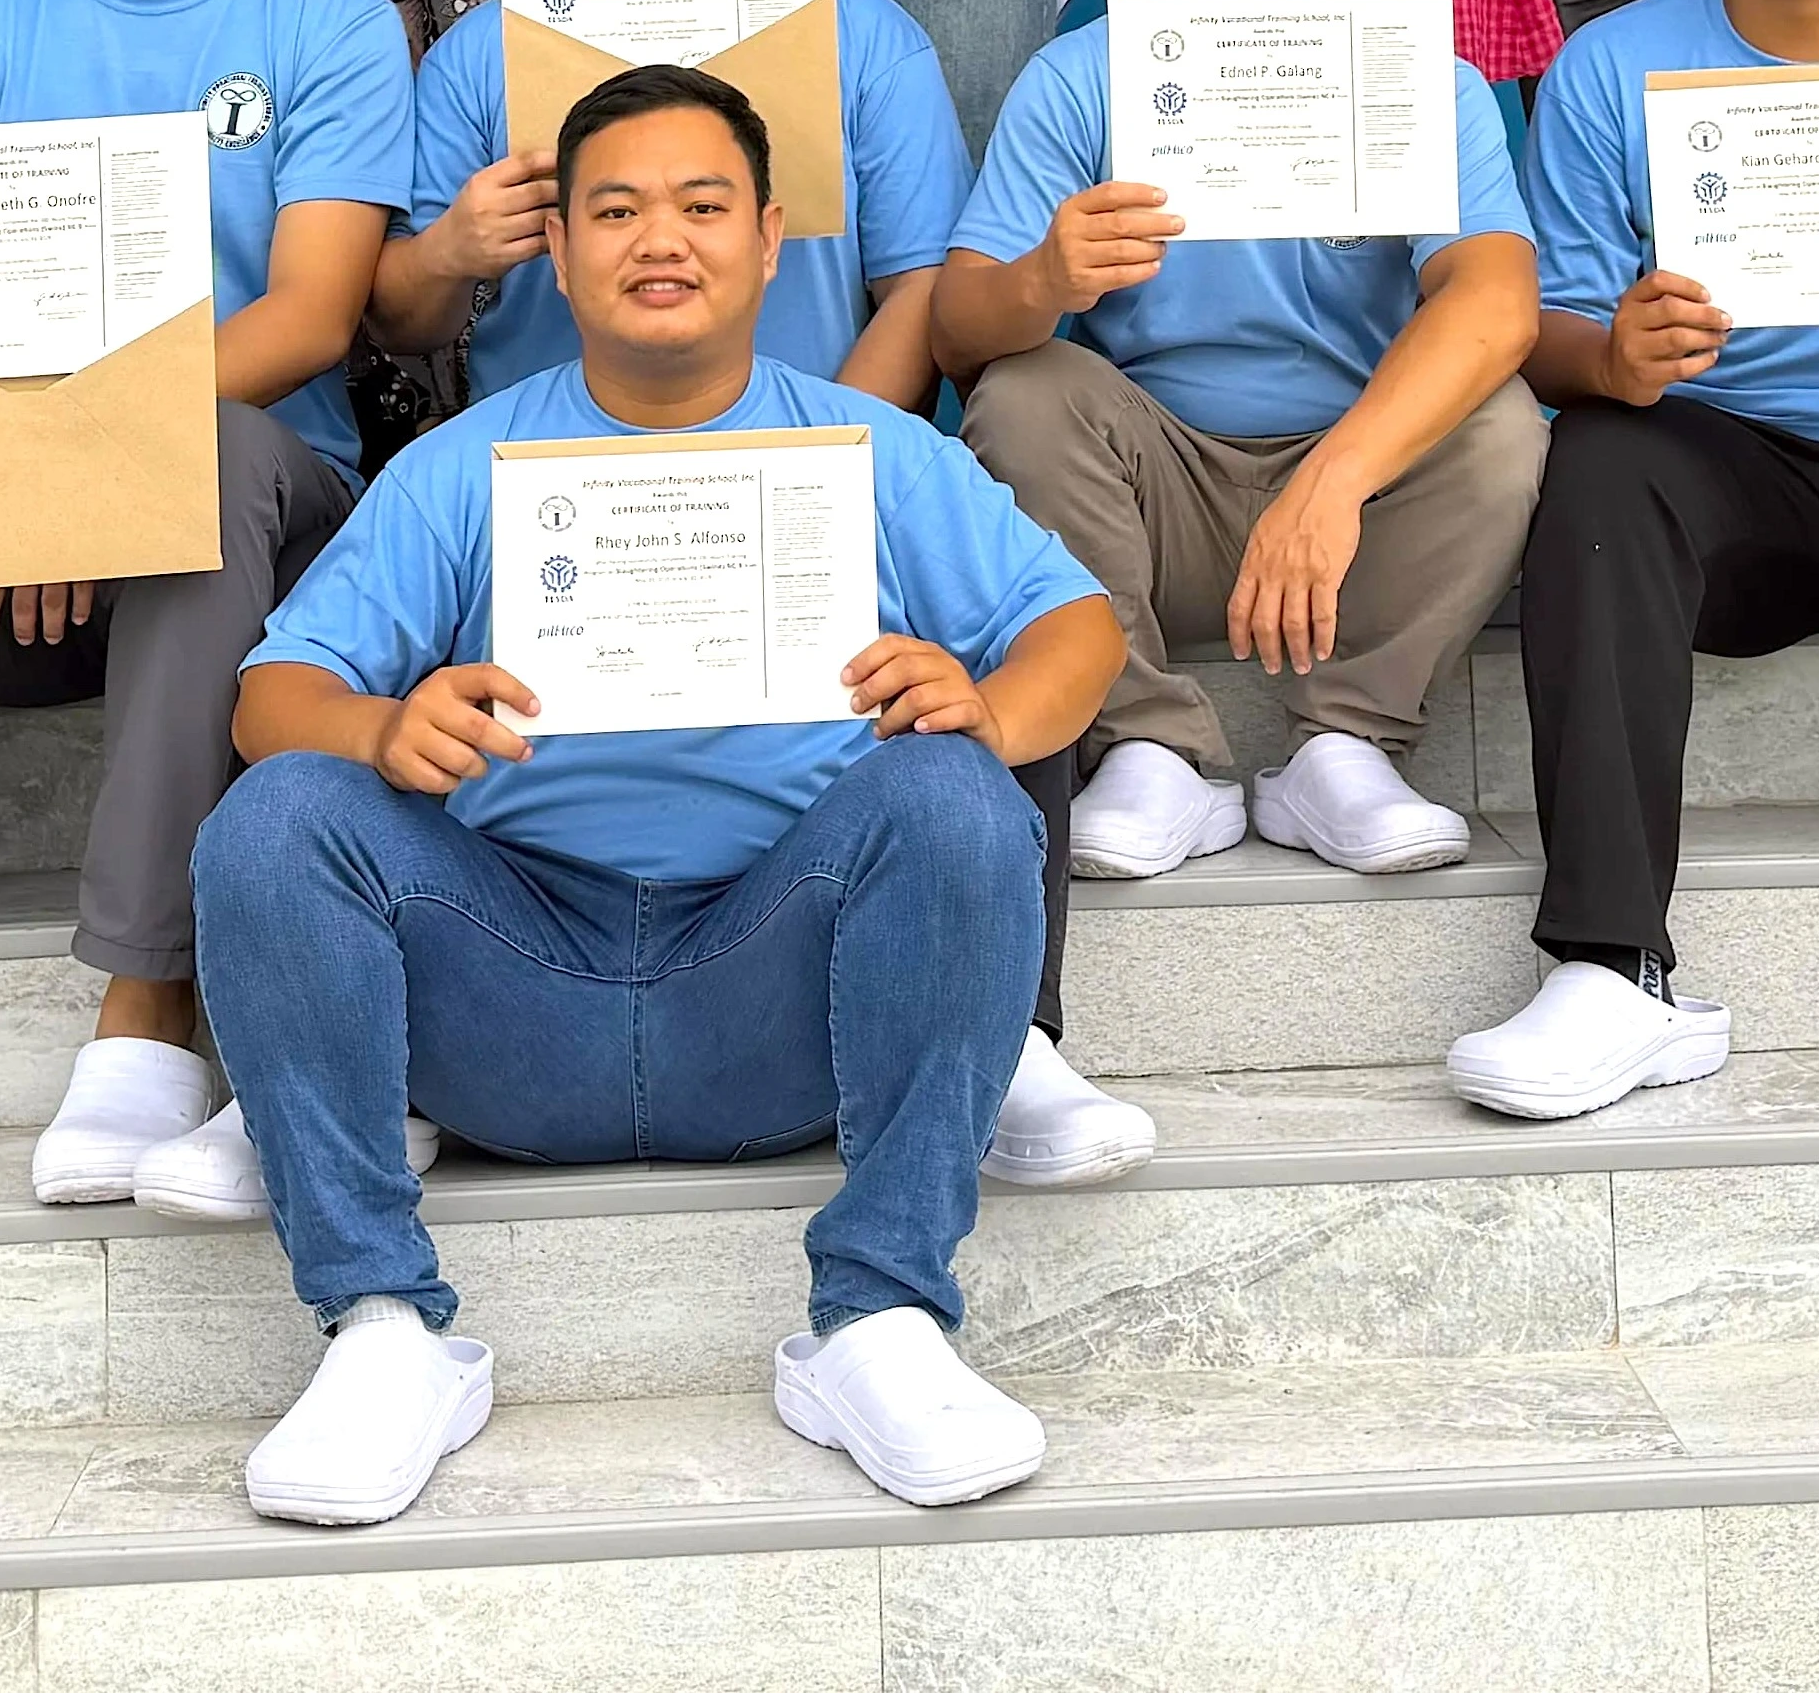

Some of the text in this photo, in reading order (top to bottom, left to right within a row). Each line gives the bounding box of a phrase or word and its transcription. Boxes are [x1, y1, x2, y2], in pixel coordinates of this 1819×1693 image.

[1220, 65, 1256, 78] Ednel
[1276, 65, 1322, 78] Galang
[1741, 155, 1770, 167] Kian
[47, 192, 96, 207] Onofre
[595, 535, 631, 550] Rhey
[635, 534, 669, 547] John
[690, 530, 746, 544] Alfonso
